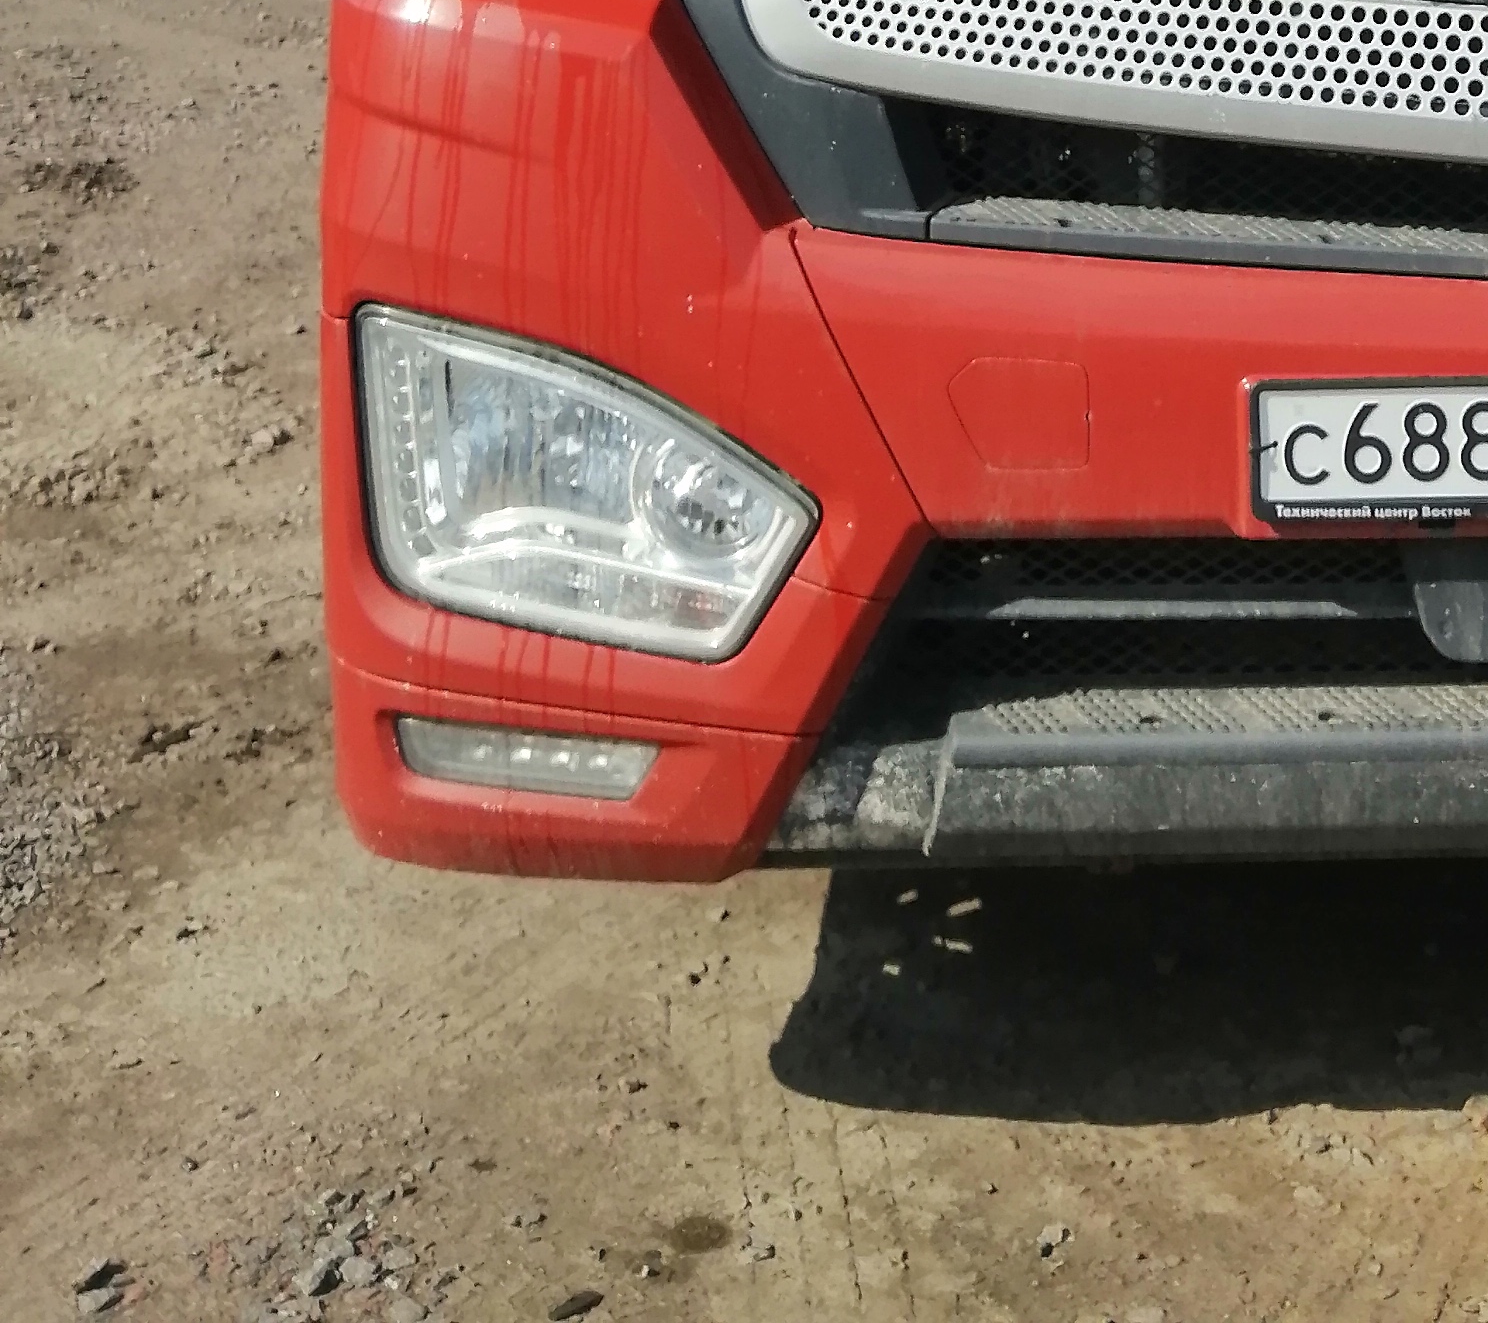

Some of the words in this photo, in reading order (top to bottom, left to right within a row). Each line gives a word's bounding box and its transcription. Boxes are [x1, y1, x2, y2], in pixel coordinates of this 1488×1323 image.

[1274, 504, 1371, 519] Технический
[1374, 506, 1419, 521] центр
[1421, 505, 1472, 518] Восток
